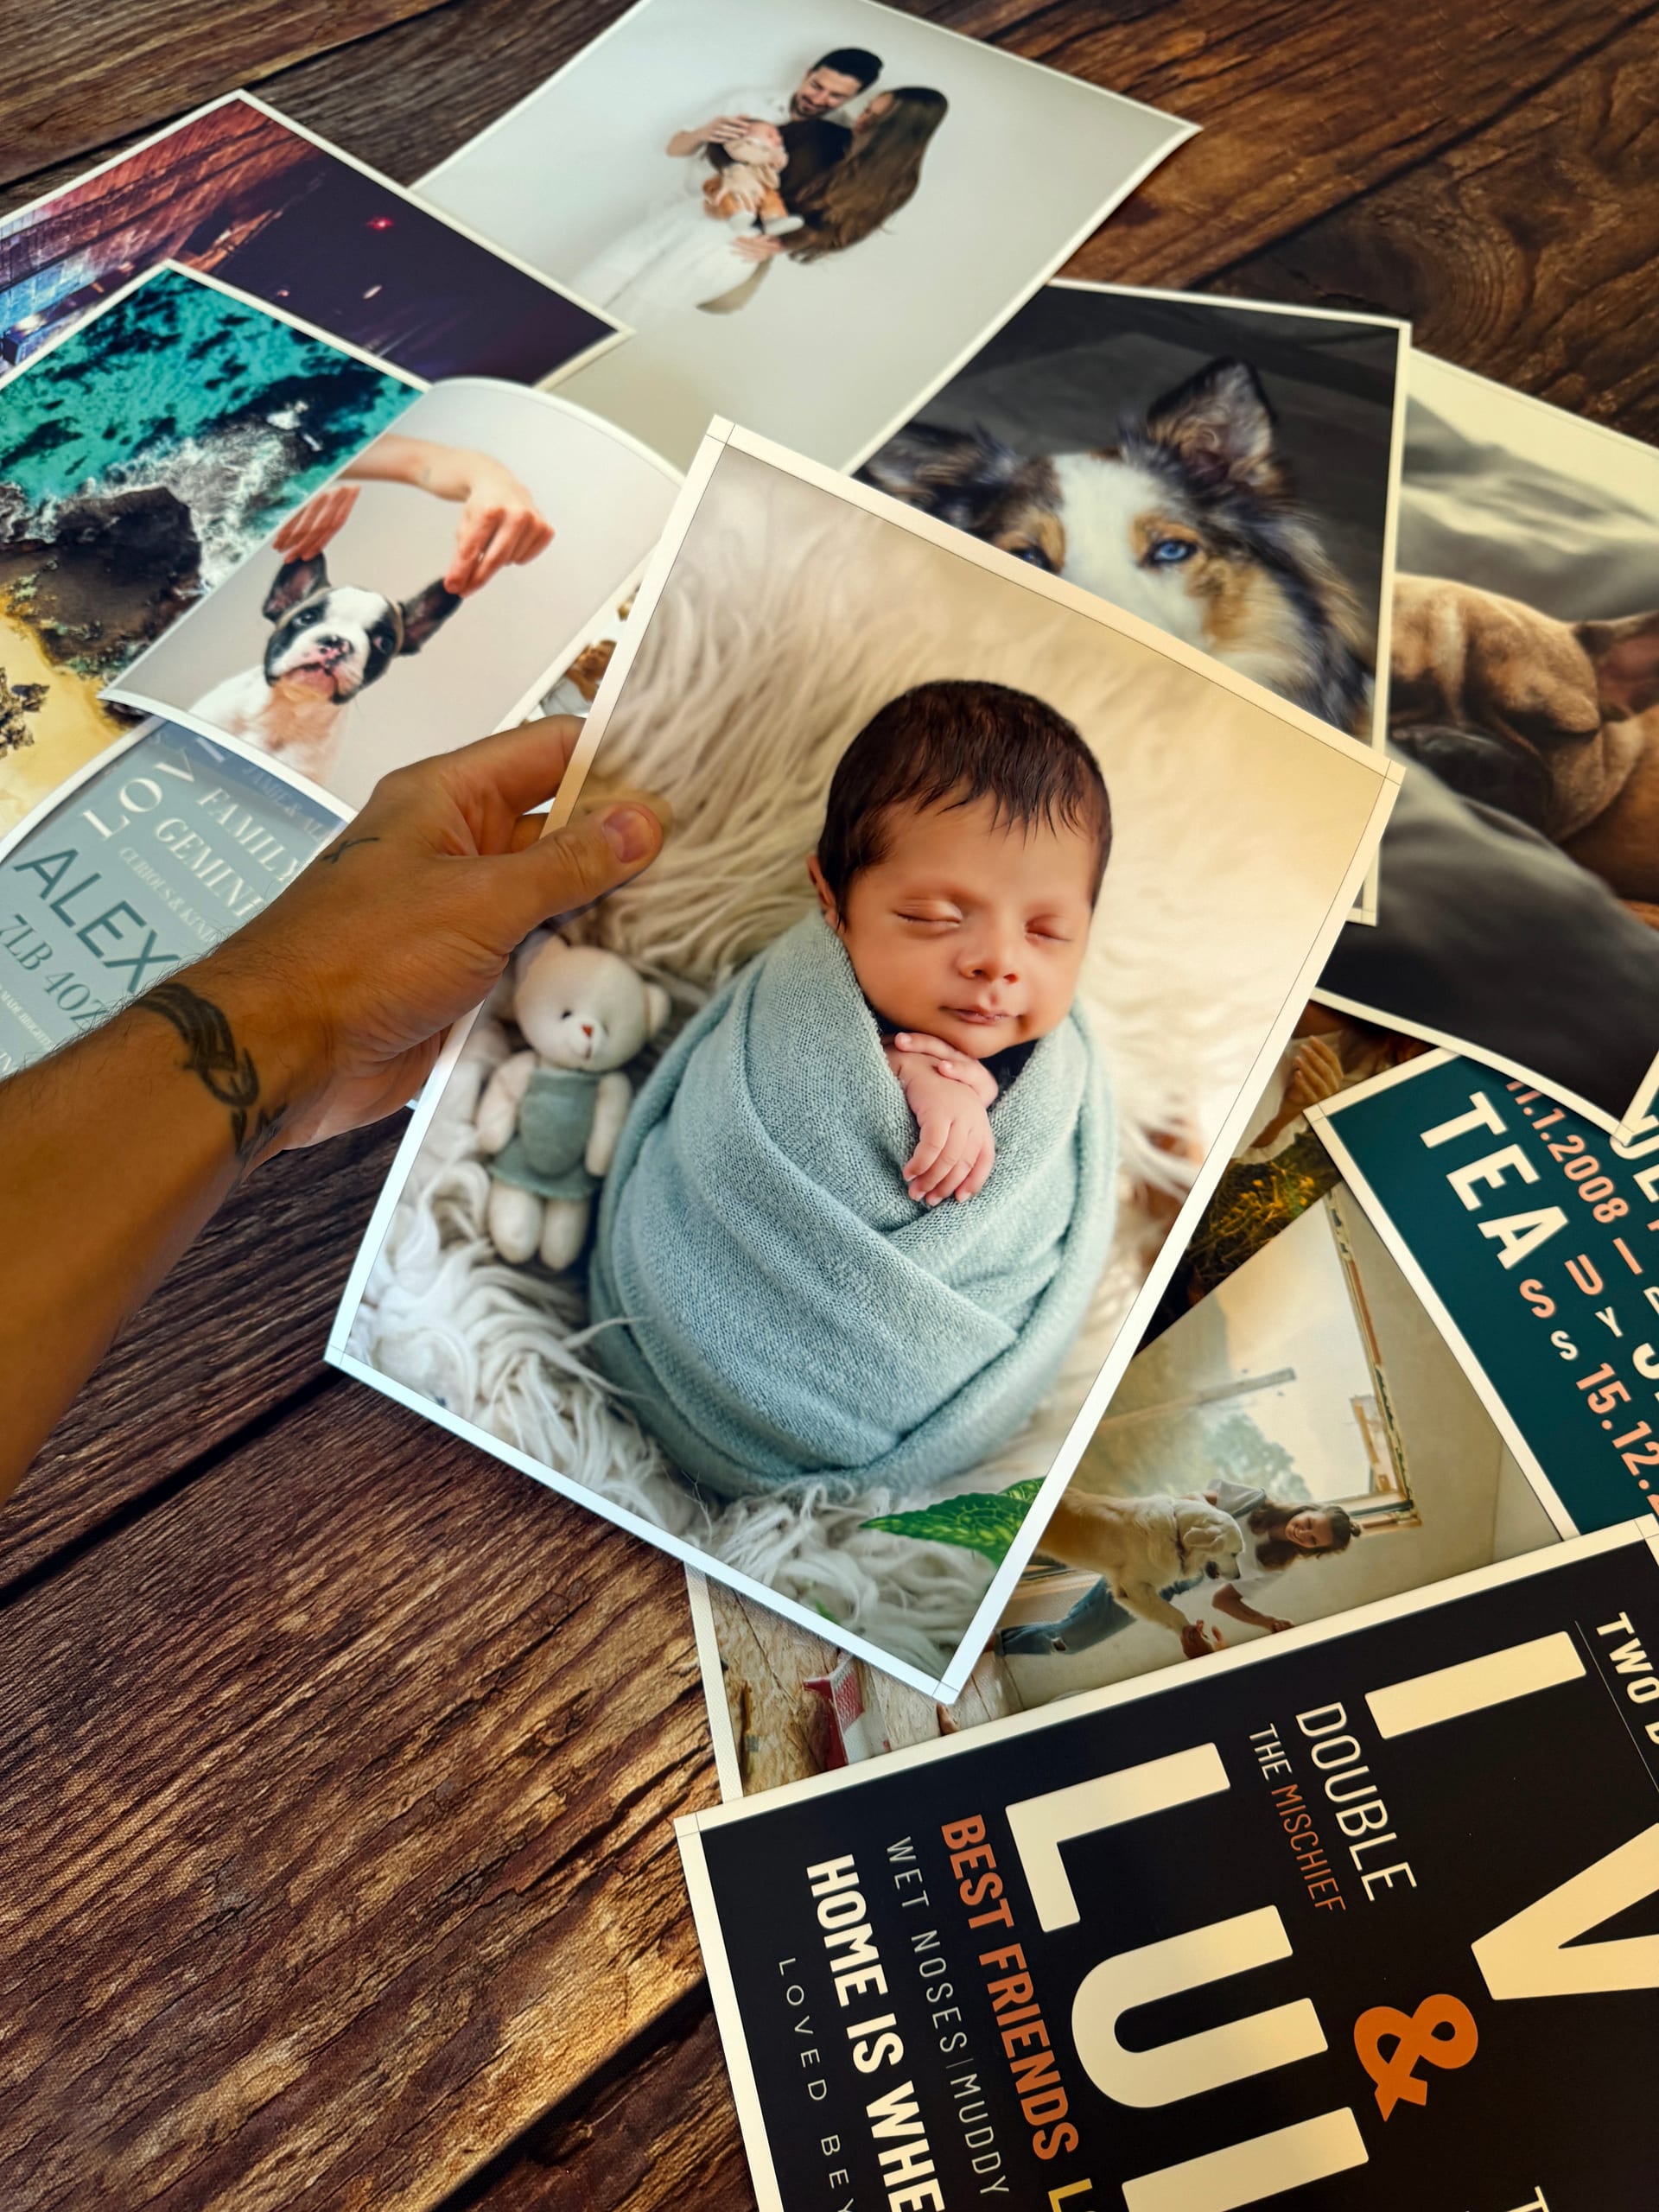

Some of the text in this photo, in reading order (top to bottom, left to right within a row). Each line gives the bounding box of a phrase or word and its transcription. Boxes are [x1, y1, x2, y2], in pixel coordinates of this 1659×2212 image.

[155, 817, 265, 917] GEMINI
[196, 787, 301, 882] FAMILY
[0, 912, 54, 970] 7LB
[13, 848, 181, 993] ALEX
[1420, 1091, 1569, 1270] TEA
[1519, 1219, 1659, 1319] SUI
[1596, 1611, 1659, 1704] TWO
[1249, 1723, 1347, 1913] THE MISCHIEF
[1296, 1701, 1417, 1902] DOUBLE
[887, 1835, 930, 1910] WET
[779, 1957, 828, 2101] LOVED
[806, 1853, 888, 2007] HOME
[847, 2012, 905, 2074] IS
[941, 1814, 1014, 1929] BEST
[978, 1942, 1079, 2160] FRIENDS
[1353, 1993, 1478, 2121] &
